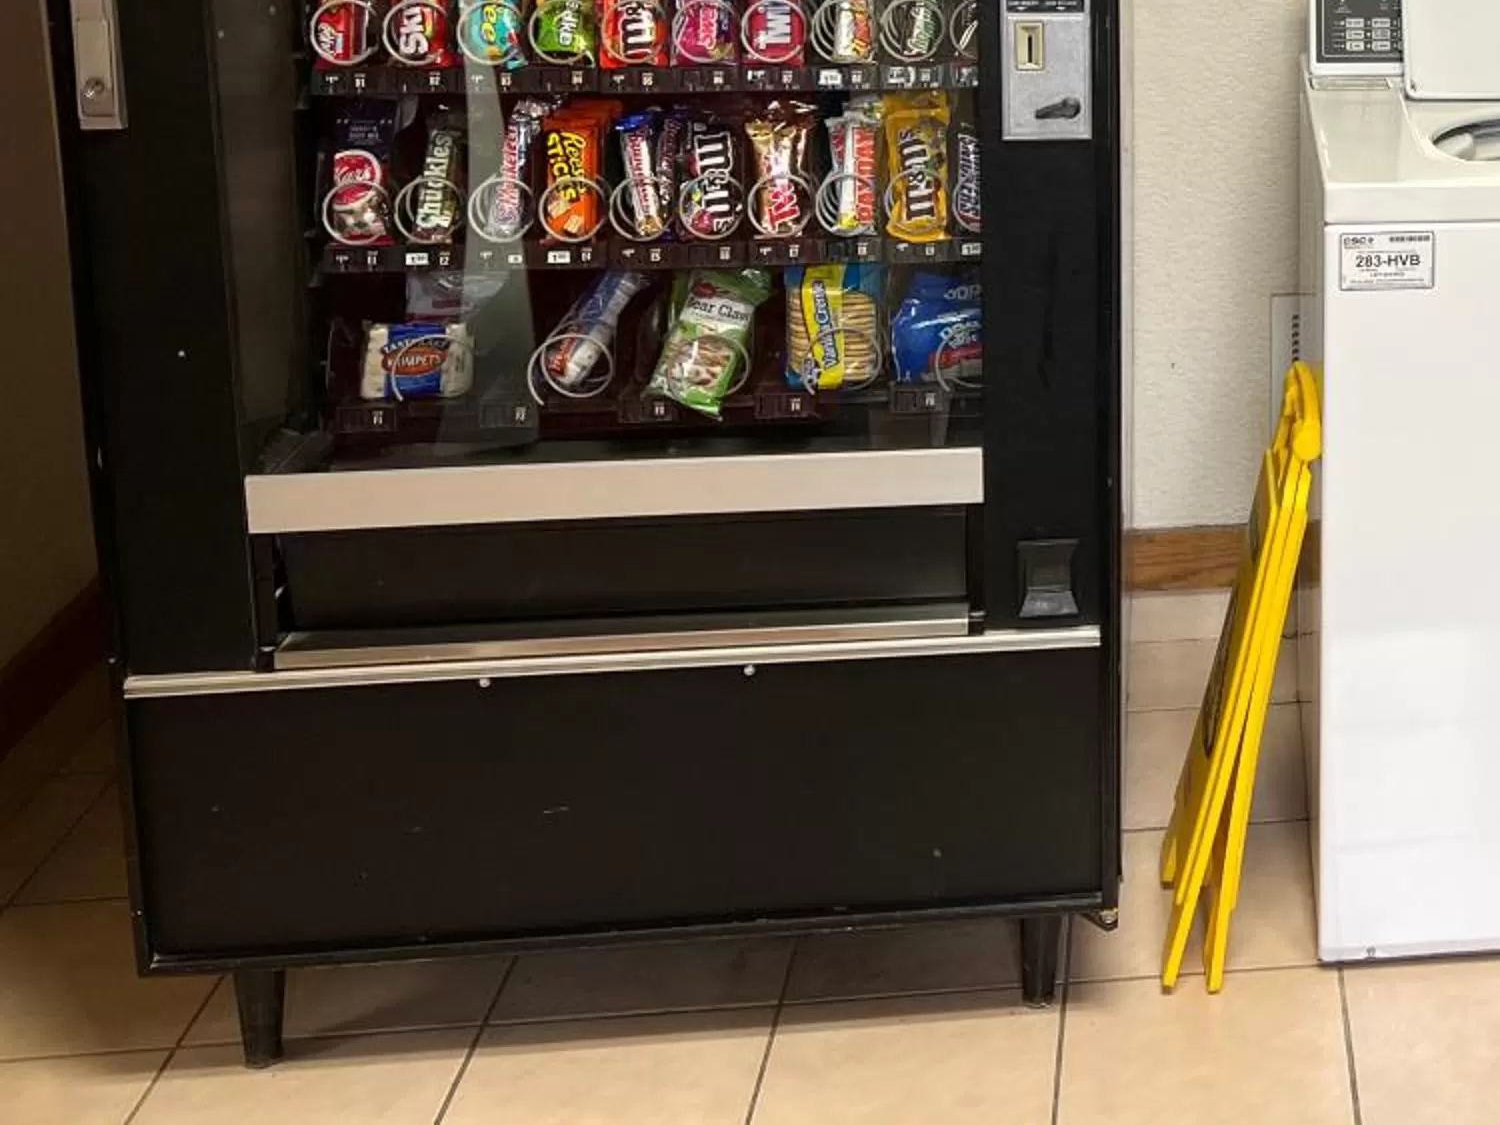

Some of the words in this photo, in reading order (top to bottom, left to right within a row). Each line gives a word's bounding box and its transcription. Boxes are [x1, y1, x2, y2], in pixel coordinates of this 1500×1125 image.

[416, 129, 453, 228] Chuckles
[854, 128, 876, 225] PAYDAY
[1355, 254, 1421, 268] 283-HVB
[688, 296, 716, 314] Bear
[717, 304, 749, 322] Claw
